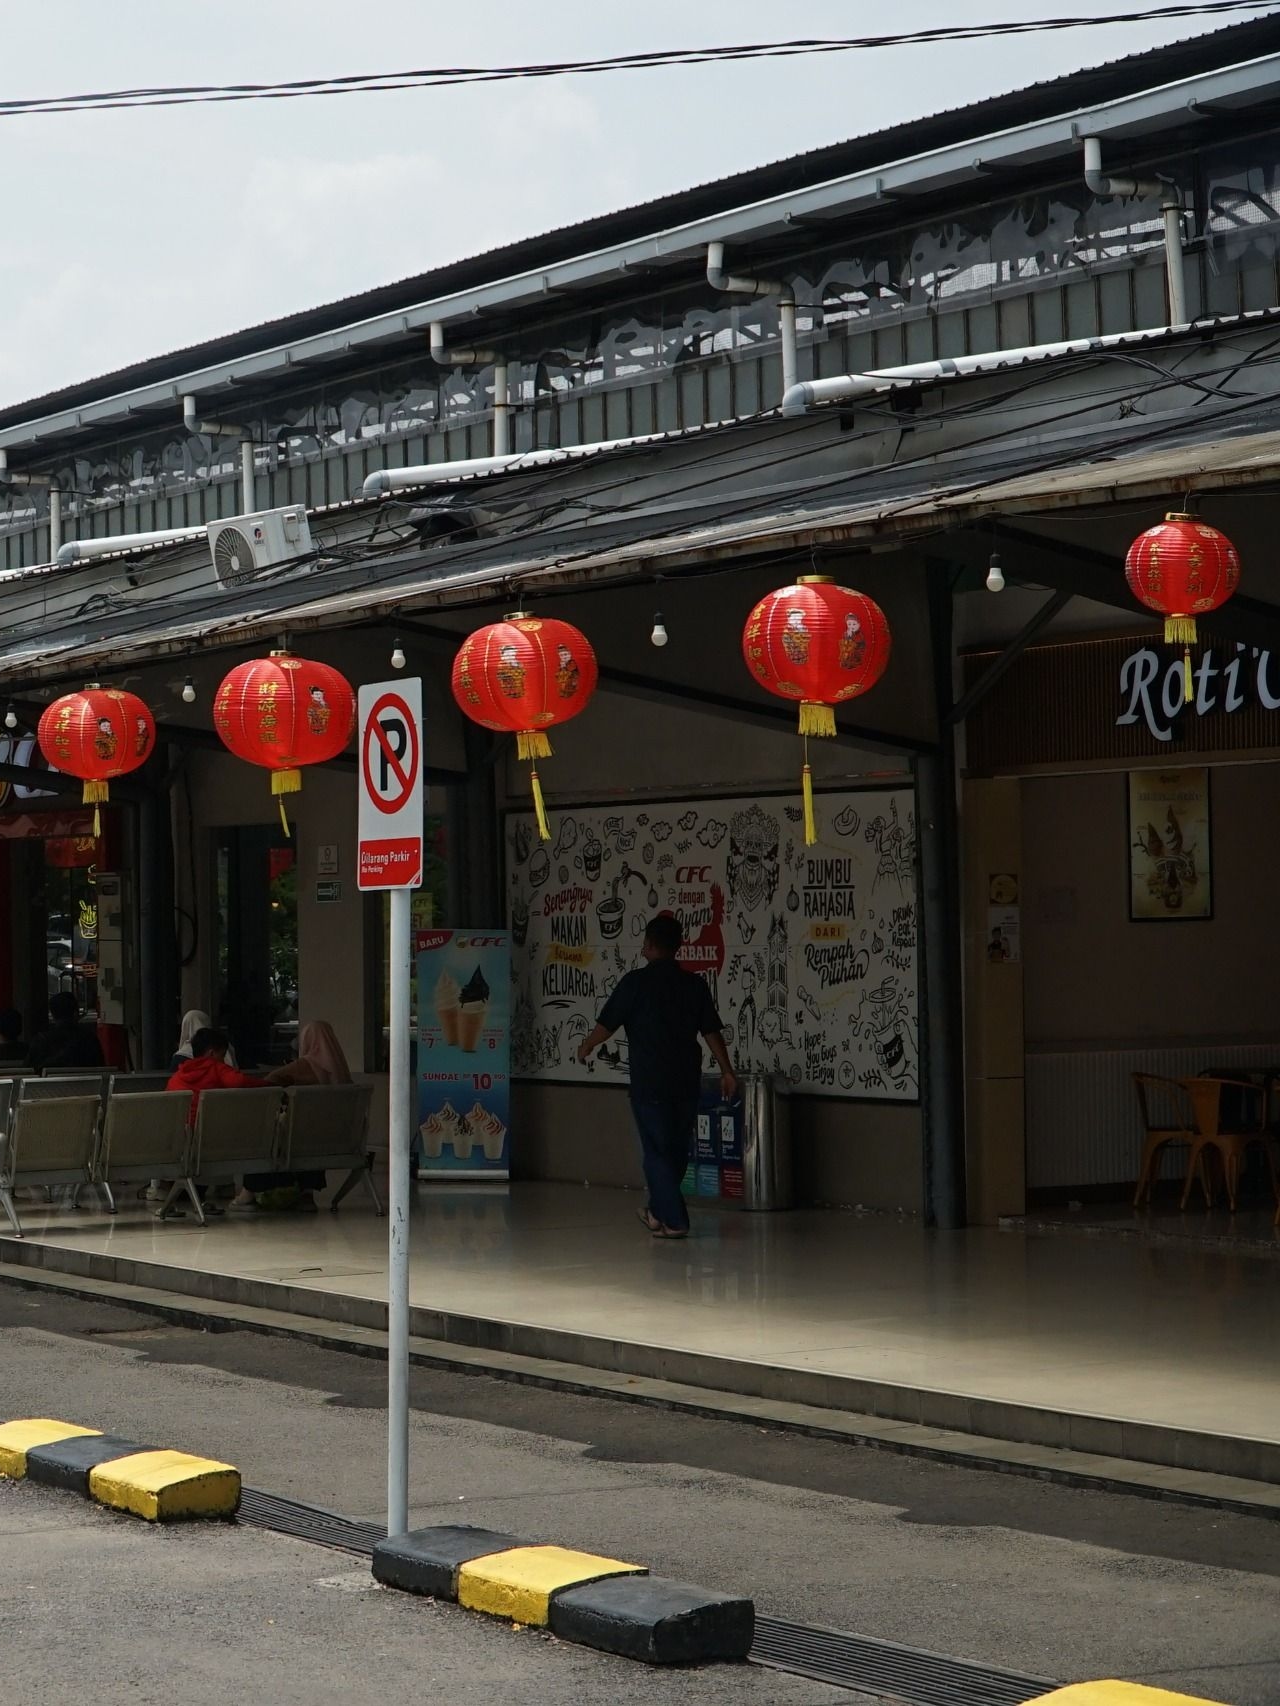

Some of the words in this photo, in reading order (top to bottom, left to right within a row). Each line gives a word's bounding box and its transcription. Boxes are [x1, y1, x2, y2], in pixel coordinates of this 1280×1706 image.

[361, 851, 389, 865] Dilarang
[390, 850, 410, 862] Parkir
[675, 865, 712, 884] CFC
[805, 858, 853, 887] BUMBU
[543, 886, 593, 917] Senangnya
[678, 887, 705, 908] dengan
[804, 891, 855, 921] RAHASIA
[551, 915, 587, 947] MAKAN
[815, 927, 841, 937] DARI
[419, 935, 444, 949] BARU
[470, 936, 506, 947] CFC
[805, 938, 856, 971] Rempah
[542, 963, 596, 997] KELUARGA
[818, 957, 868, 989] Pilihan
[428, 1038, 434, 1049] 7
[488, 1038, 496, 1049] 8
[422, 1072, 460, 1081] SUNDAE
[472, 1073, 492, 1090] 10
[812, 1065, 835, 1085] Enjoy
